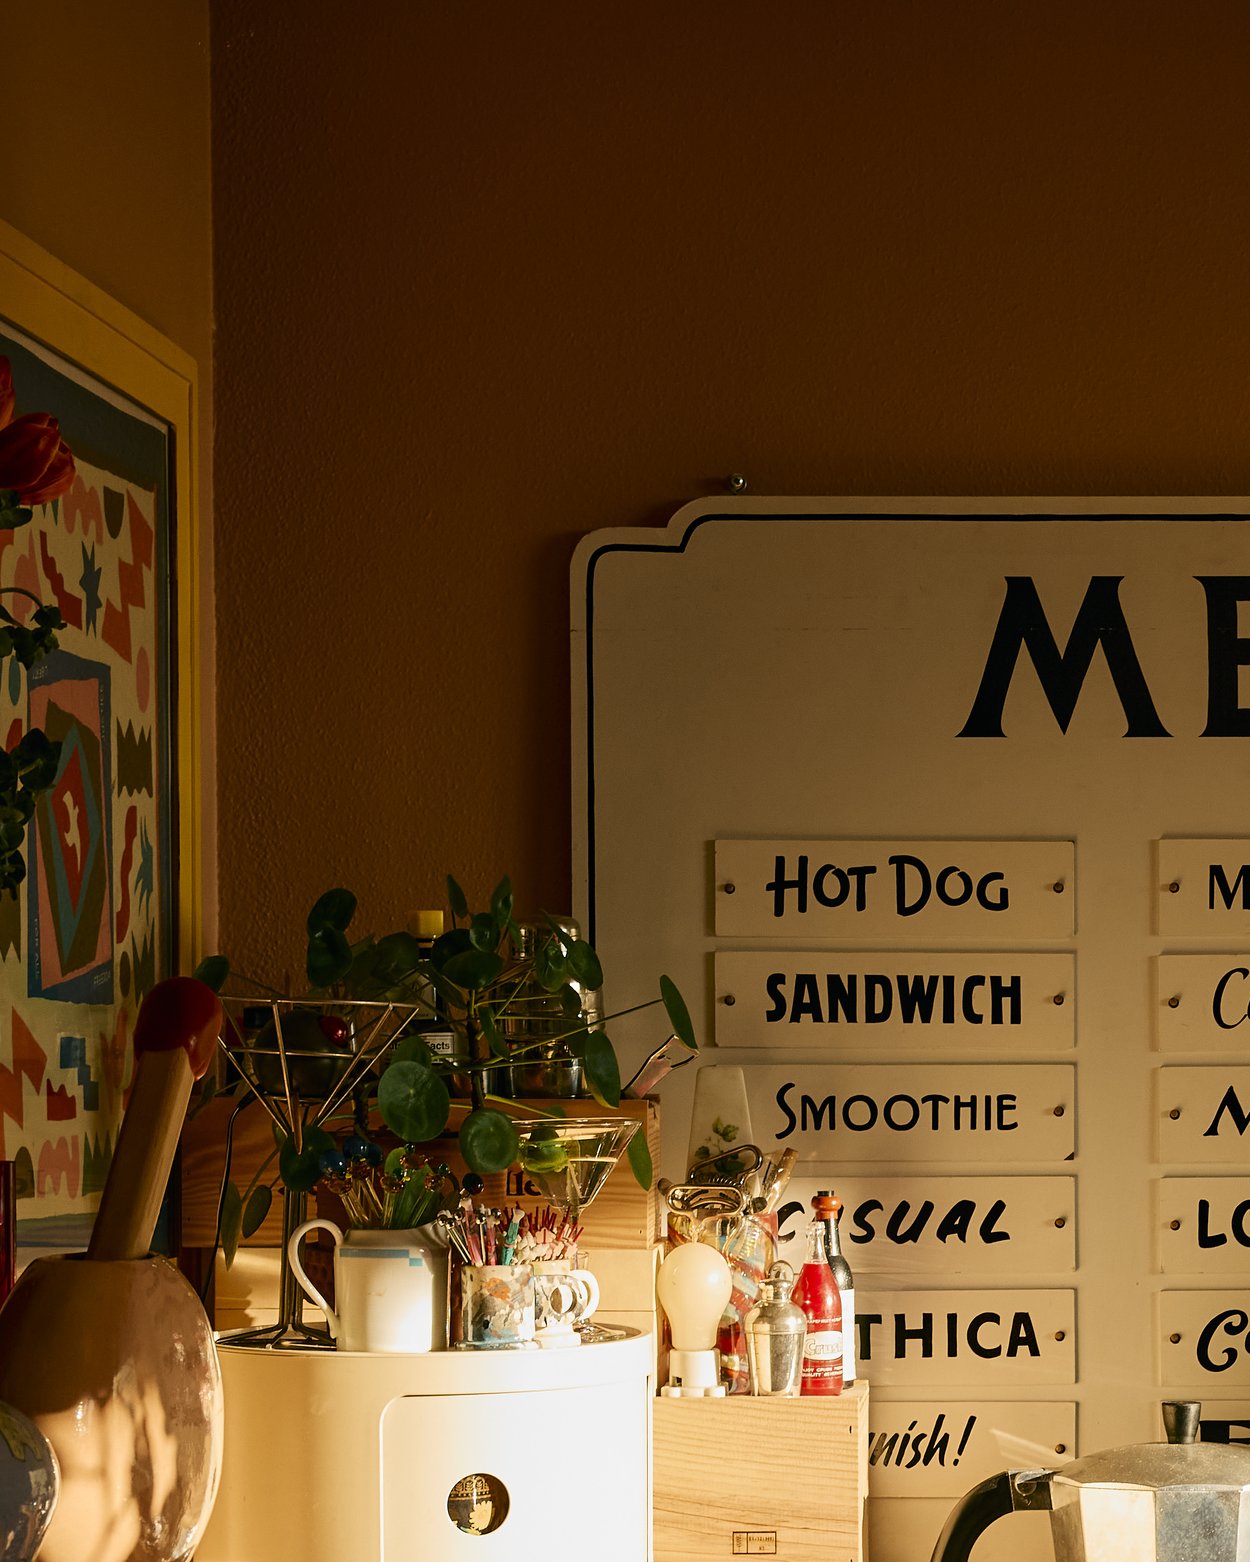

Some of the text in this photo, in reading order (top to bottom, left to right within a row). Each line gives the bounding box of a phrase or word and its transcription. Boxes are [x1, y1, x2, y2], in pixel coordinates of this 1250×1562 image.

[765, 855, 1010, 917] HOT DOG
[765, 972, 1023, 1026] SANDWICH
[774, 1081, 1019, 1141] SMOOTHIE
[777, 1198, 1012, 1245] CSUAL
[853, 1311, 1042, 1362] THICA
[868, 1413, 979, 1471] nish!
